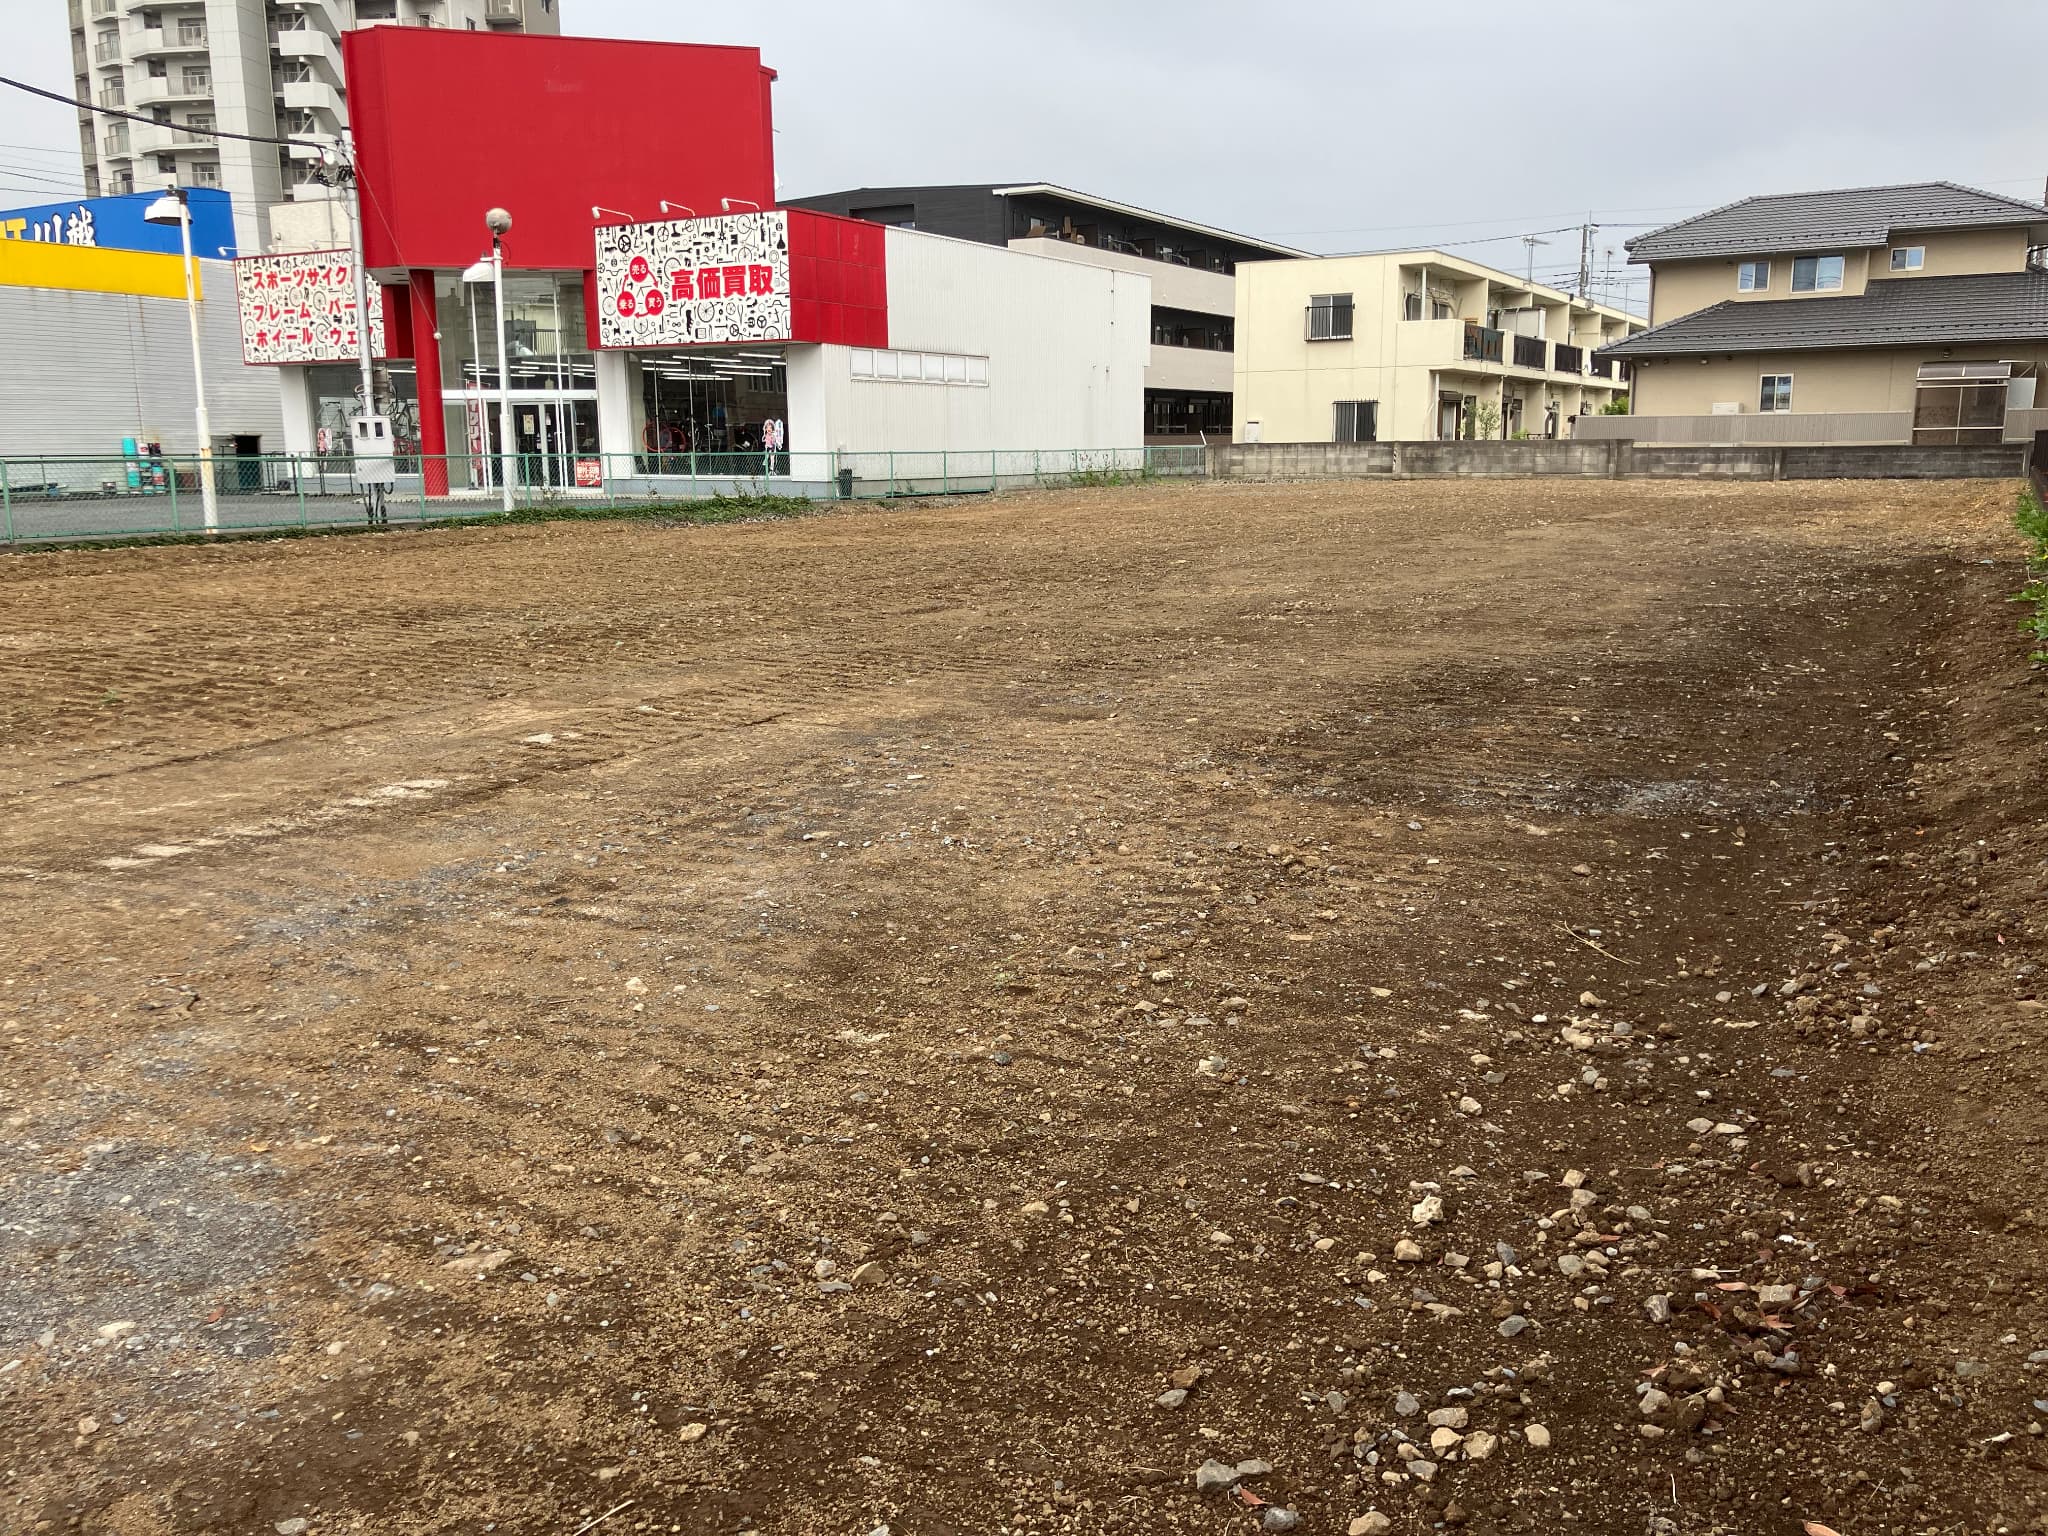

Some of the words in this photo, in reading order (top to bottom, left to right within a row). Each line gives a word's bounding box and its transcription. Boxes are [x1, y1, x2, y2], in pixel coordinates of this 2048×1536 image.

[252, 265, 353, 290] スポーツサイク
[631, 261, 647, 275] 売る
[670, 264, 776, 302] 高価買取
[647, 296, 663, 309] 買う
